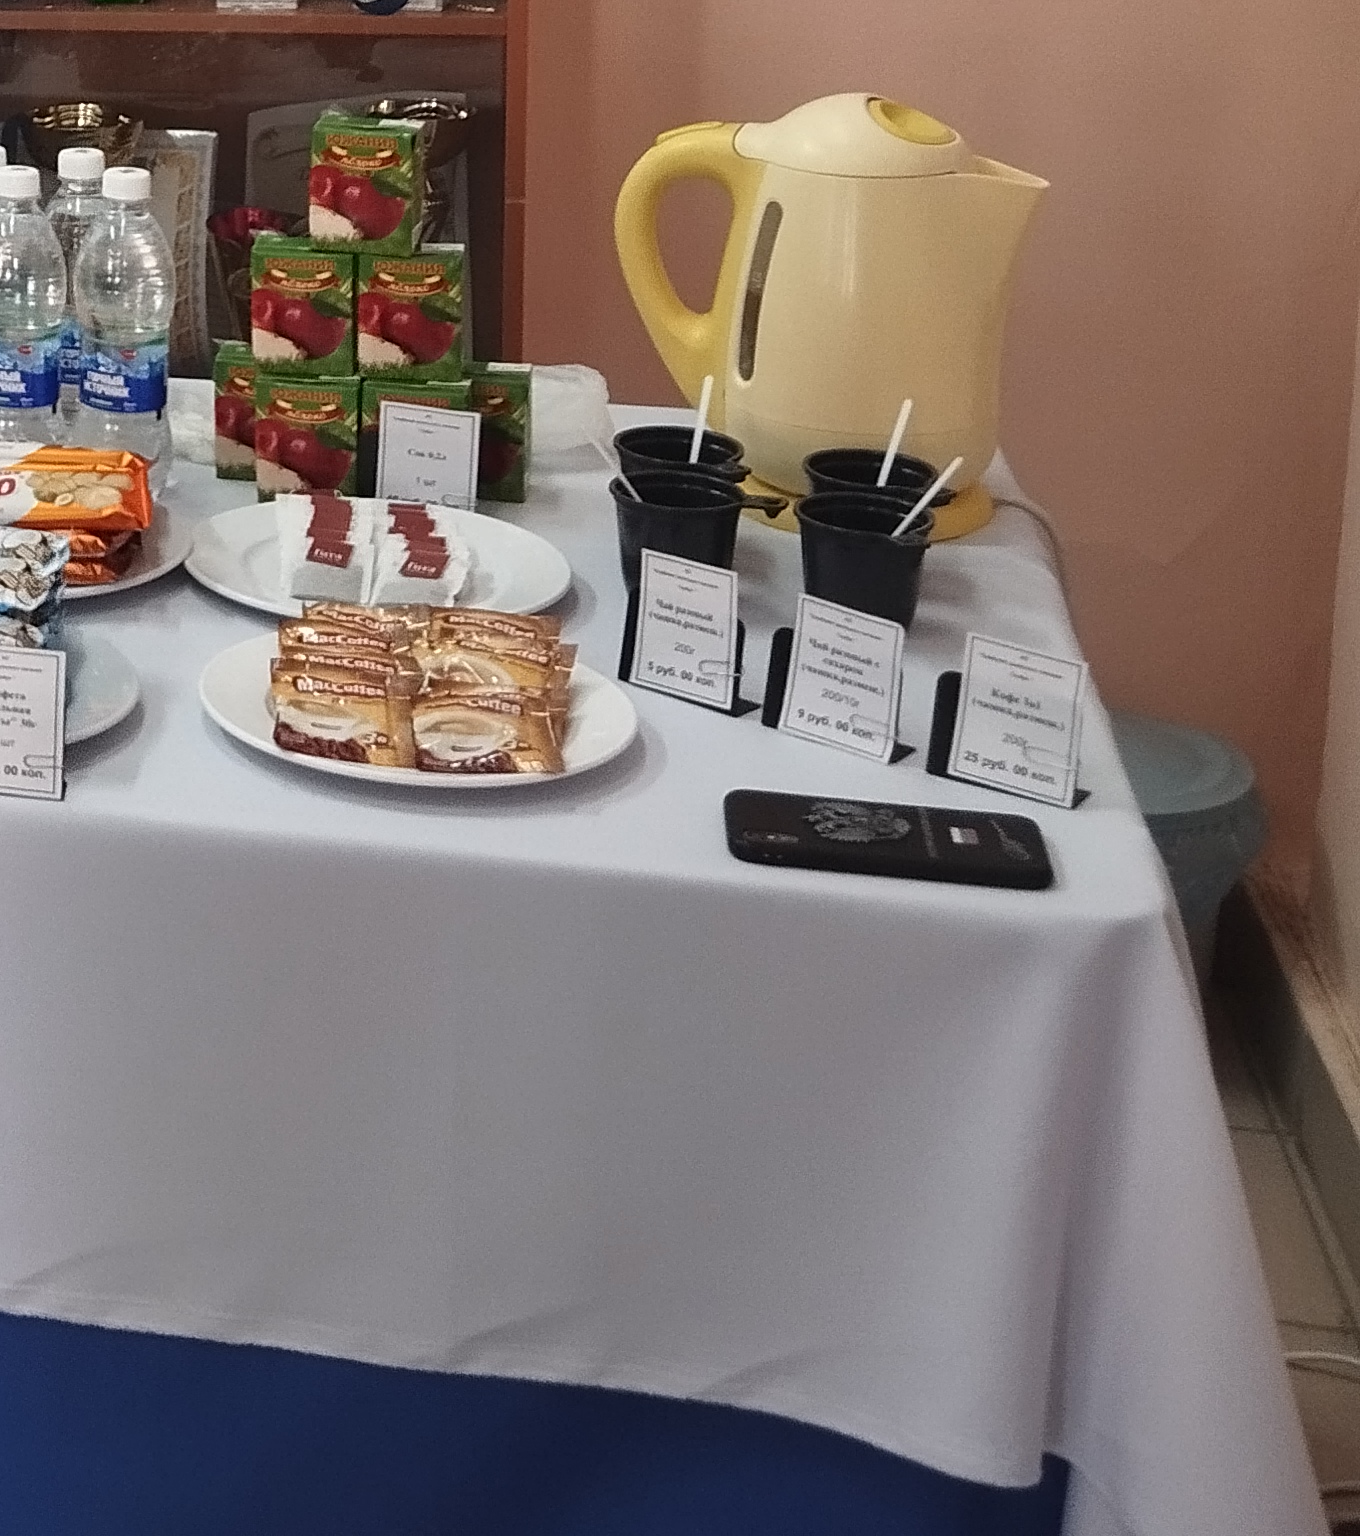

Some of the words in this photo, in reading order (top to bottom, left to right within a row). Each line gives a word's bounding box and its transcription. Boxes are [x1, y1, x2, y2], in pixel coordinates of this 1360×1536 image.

[681, 669, 693, 682] 00
[807, 712, 832, 727] руб.
[836, 719, 849, 732] 00
[3, 764, 19, 776] 00
[1012, 763, 1028, 777] 00
